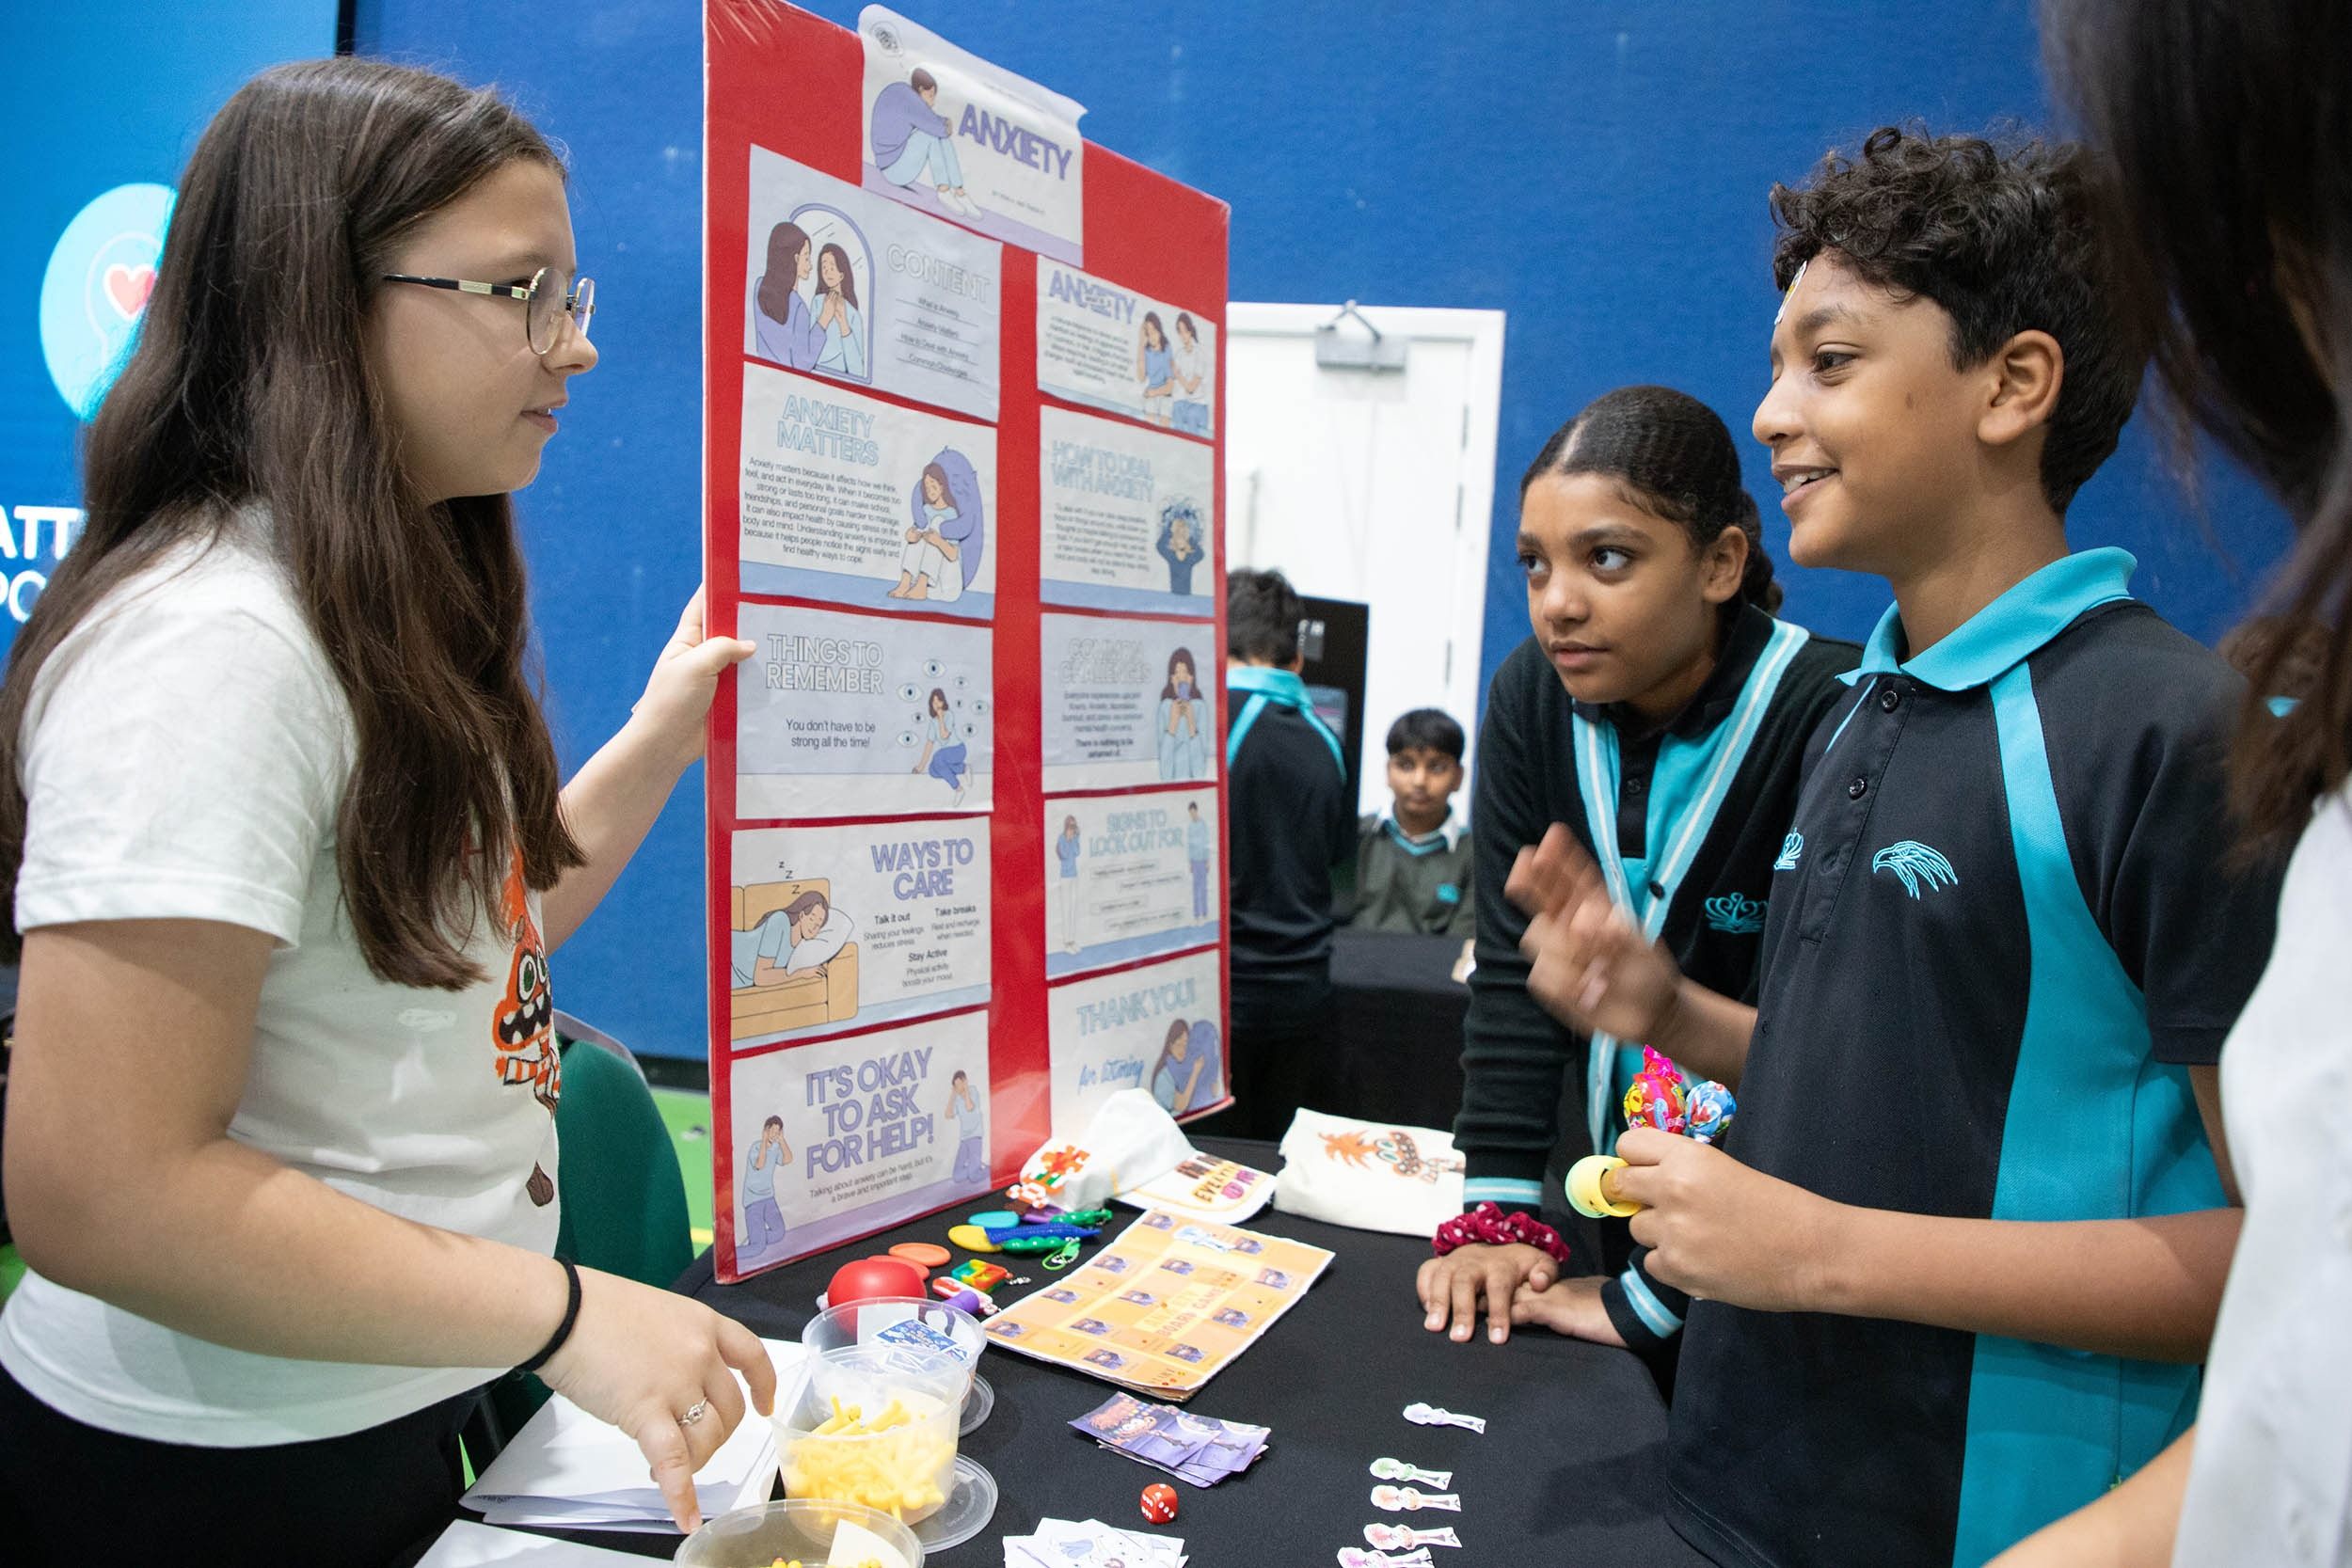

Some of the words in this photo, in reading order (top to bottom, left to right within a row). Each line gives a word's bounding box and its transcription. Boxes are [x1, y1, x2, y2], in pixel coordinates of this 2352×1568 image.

[958, 103, 1073, 181] ANXIETY
[886, 243, 992, 304] CONTENT
[782, 394, 876, 437] ANXIETY
[777, 420, 880, 467] MATTERS
[767, 634, 851, 666] THINGS
[853, 641, 884, 668] TO
[766, 662, 884, 694] REMEMBER
[787, 719, 804, 732] You
[806, 720, 829, 733] don't
[831, 721, 852, 733] have
[854, 721, 864, 732] to
[865, 722, 876, 733] be
[791, 736, 820, 750] strong
[821, 736, 832, 748] all
[834, 736, 848, 747] the
[870, 840, 942, 873] WAYS
[944, 838, 974, 865] TO
[1089, 832, 1128, 858] LOOK
[1129, 829, 1156, 851] OUT
[1158, 827, 1184, 848] FOR
[894, 868, 954, 901] CARE
[875, 914, 890, 925] Talk
[891, 913, 897, 923] it
[898, 912, 911, 922] out
[935, 907, 951, 916] Take
[953, 905, 977, 914] breaks
[909, 952, 924, 962] Stay
[926, 949, 948, 958] Active
[1076, 988, 1149, 1036] THANK
[806, 1065, 854, 1106] IT'S
[857, 1046, 933, 1093] OKAY
[822, 1099, 864, 1137] TO
[866, 1083, 920, 1128] ASK
[806, 1133, 864, 1180] FOR
[867, 1114, 934, 1162] HELP!
